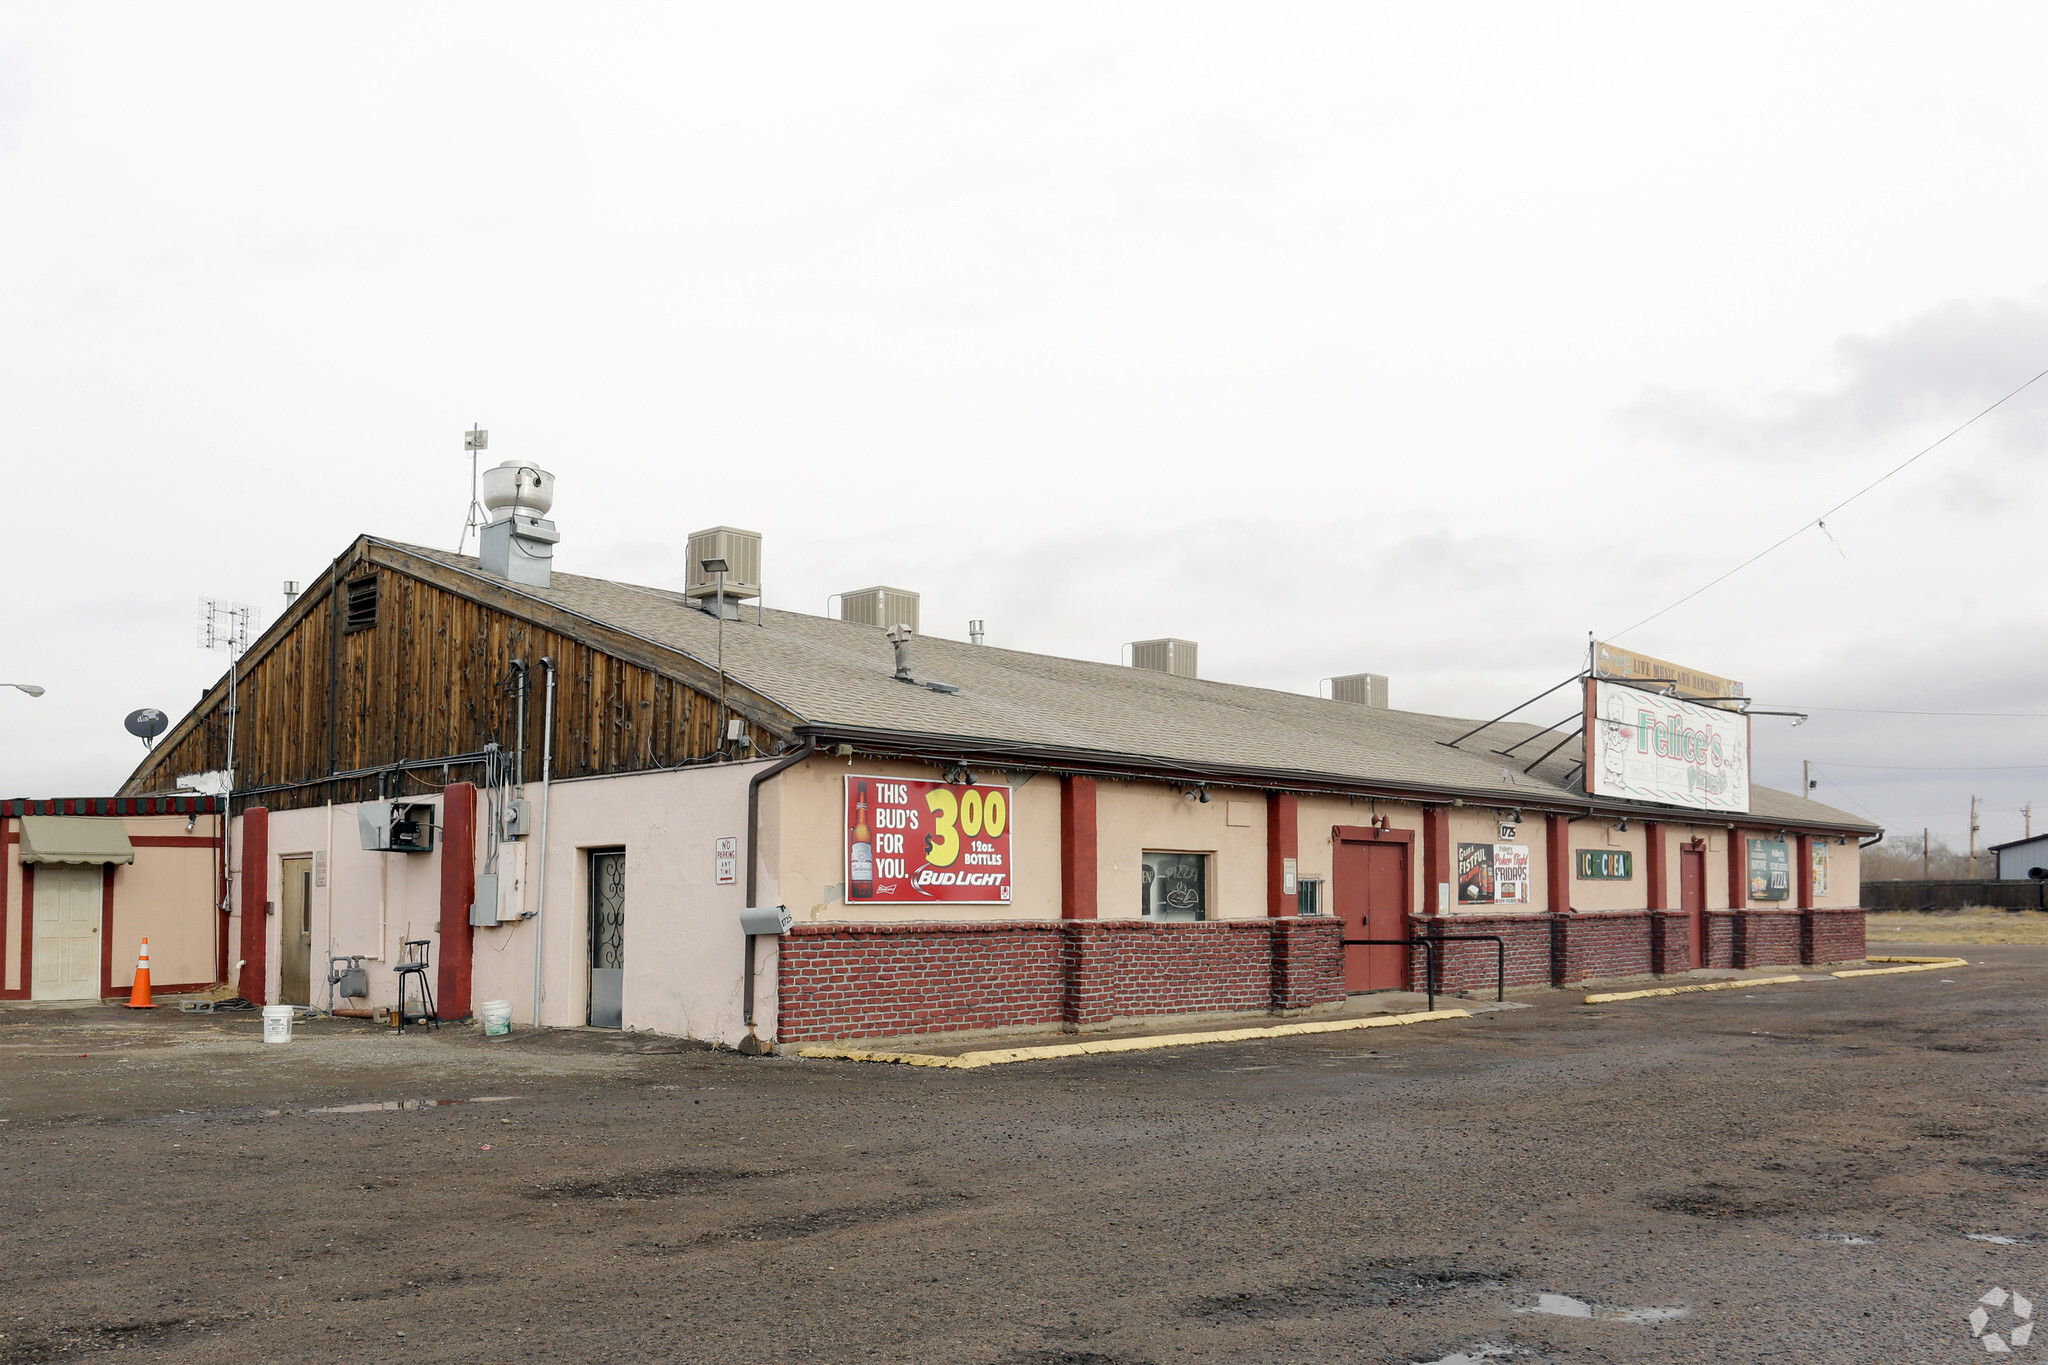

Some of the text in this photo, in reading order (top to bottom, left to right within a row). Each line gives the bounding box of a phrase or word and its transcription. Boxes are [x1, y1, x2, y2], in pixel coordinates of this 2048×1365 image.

[1633, 659, 1651, 677] LIVE
[1677, 671, 1690, 688] AND
[1637, 708, 1723, 768] Felice's
[875, 782, 908, 804] THIS
[875, 808, 919, 830] BUD'S
[722, 840, 731, 850] NO
[875, 833, 904, 854] FOR
[875, 858, 909, 879] YOU.
[964, 853, 1003, 866] BOTTLES
[1459, 848, 1487, 875] FISTFUL
[1165, 864, 1198, 882] PIZZA
[1495, 866, 1527, 881] FRIDAYS
[1771, 870, 1788, 889] PIZZA
[781, 914, 793, 927] 1725
